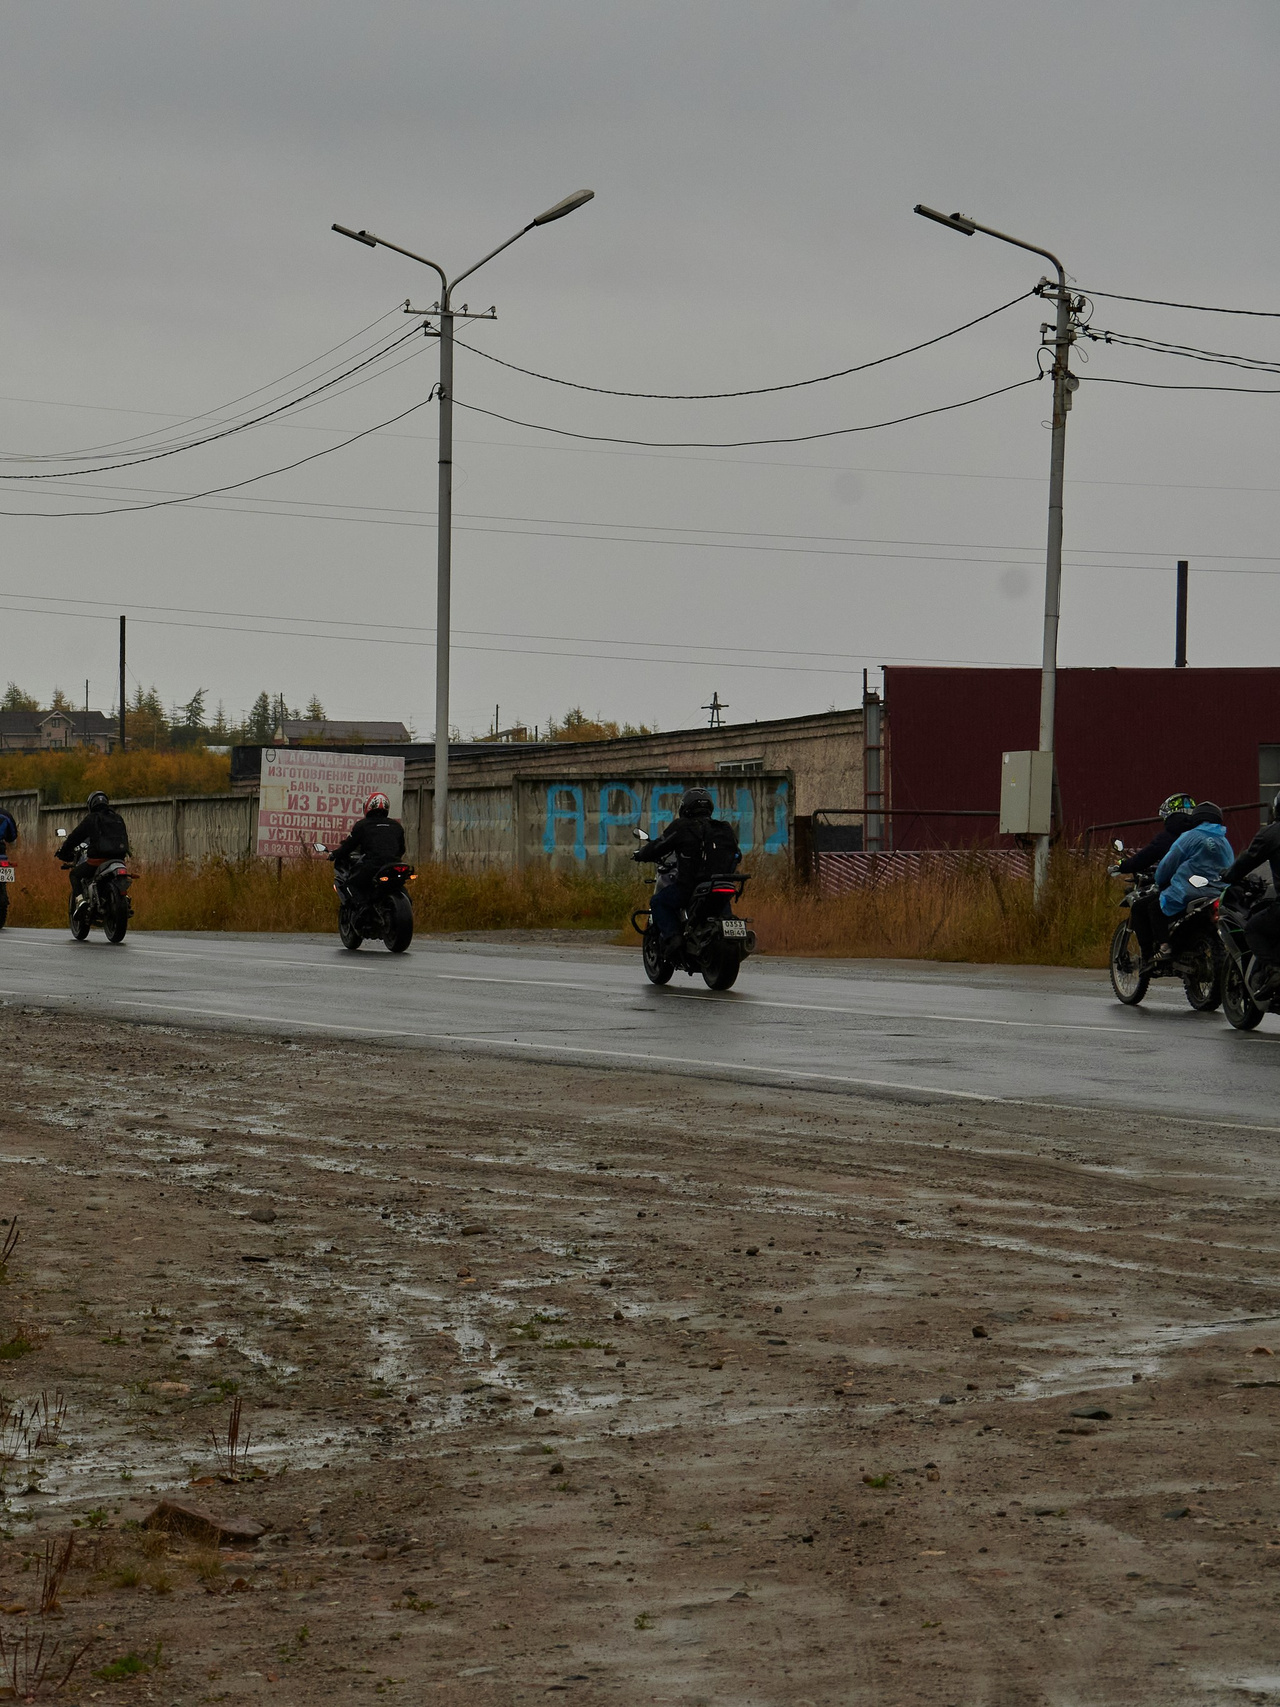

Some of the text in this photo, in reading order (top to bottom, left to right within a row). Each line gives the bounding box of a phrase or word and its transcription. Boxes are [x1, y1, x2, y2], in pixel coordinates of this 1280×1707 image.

[268, 766, 402, 786] ИЗГОТОВЛЕНИЕ ДОМОВ,
[290, 781, 323, 794] БАНЬ,
[287, 793, 363, 815] ИЗ БРУС
[269, 813, 343, 829] СТОЛЯРНЫЕ
[268, 828, 318, 844] УСЛУГИ
